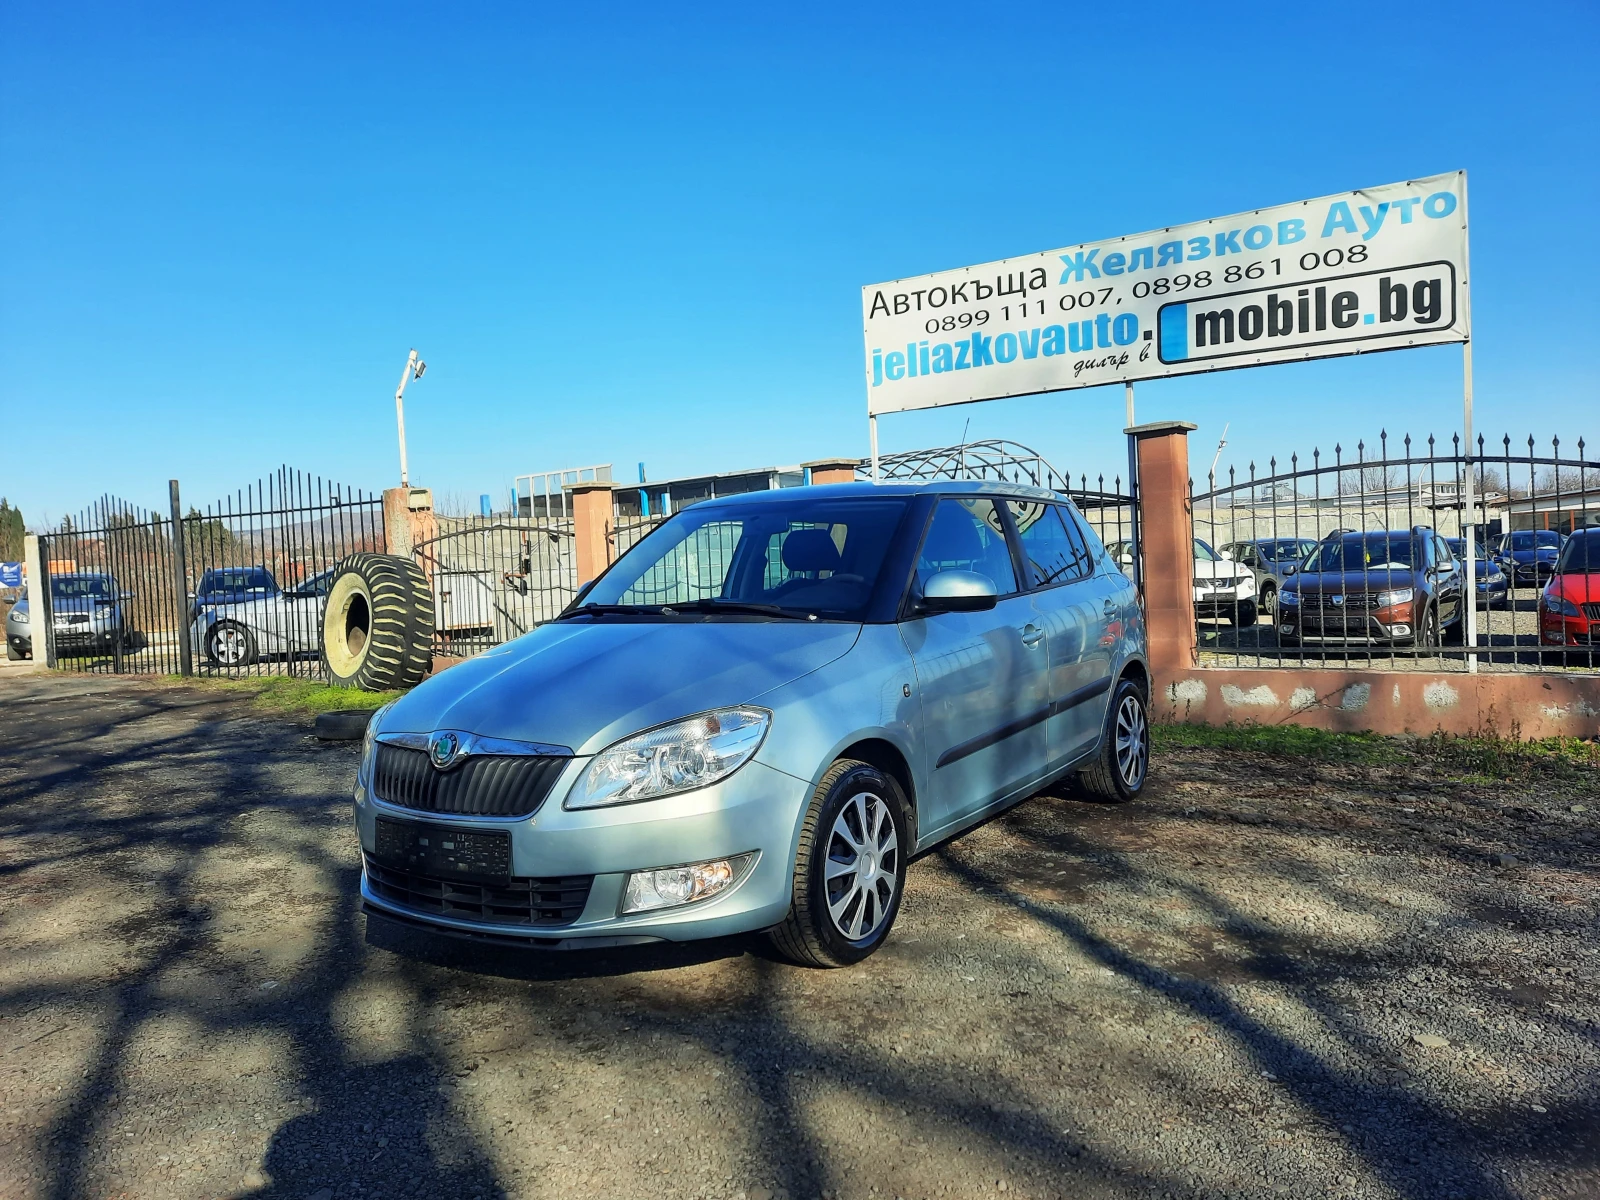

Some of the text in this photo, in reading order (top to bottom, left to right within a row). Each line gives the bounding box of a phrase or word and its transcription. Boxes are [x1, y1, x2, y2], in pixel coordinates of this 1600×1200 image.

[869, 190, 1458, 320] Автокъща Желязков Ауто
[924, 244, 1369, 335] 0899 111 007, 0898 861 008
[1195, 276, 1443, 348] mobile.bg
